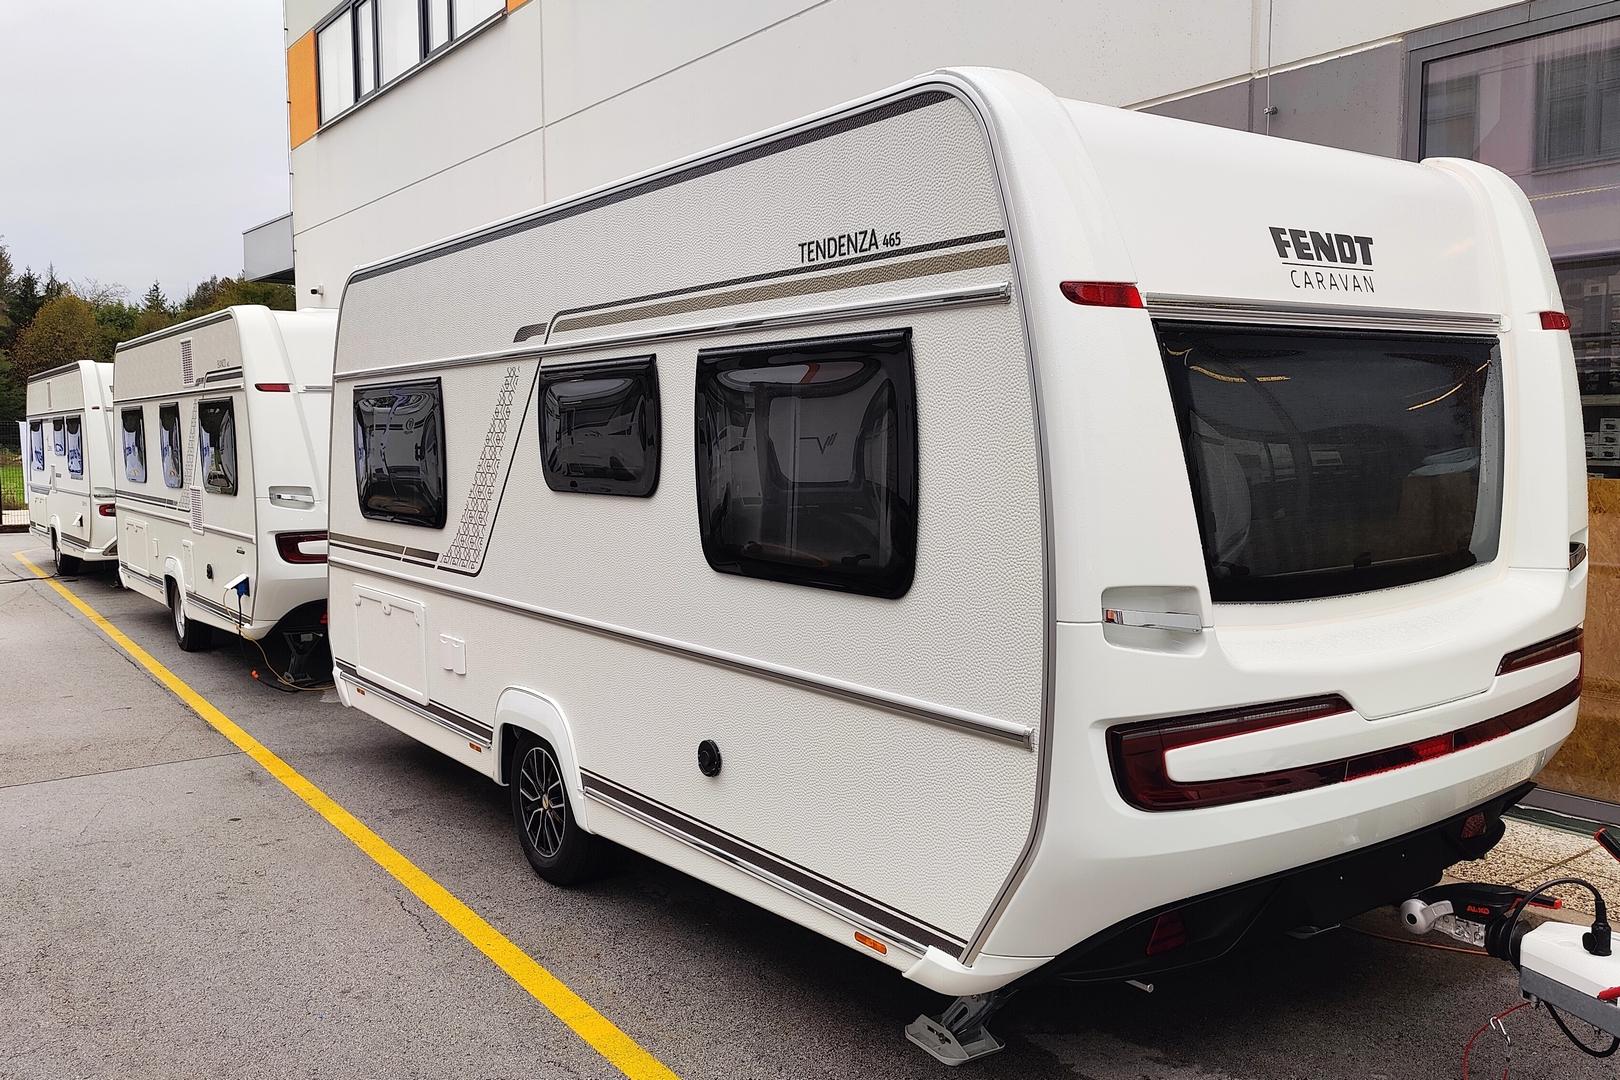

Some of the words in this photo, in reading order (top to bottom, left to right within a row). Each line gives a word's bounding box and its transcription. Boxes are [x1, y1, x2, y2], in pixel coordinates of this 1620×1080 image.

[798, 229, 878, 263] TENDENZA
[882, 231, 901, 247] 465
[1269, 226, 1373, 265] FENDT
[1290, 269, 1374, 293] CARAVAN
